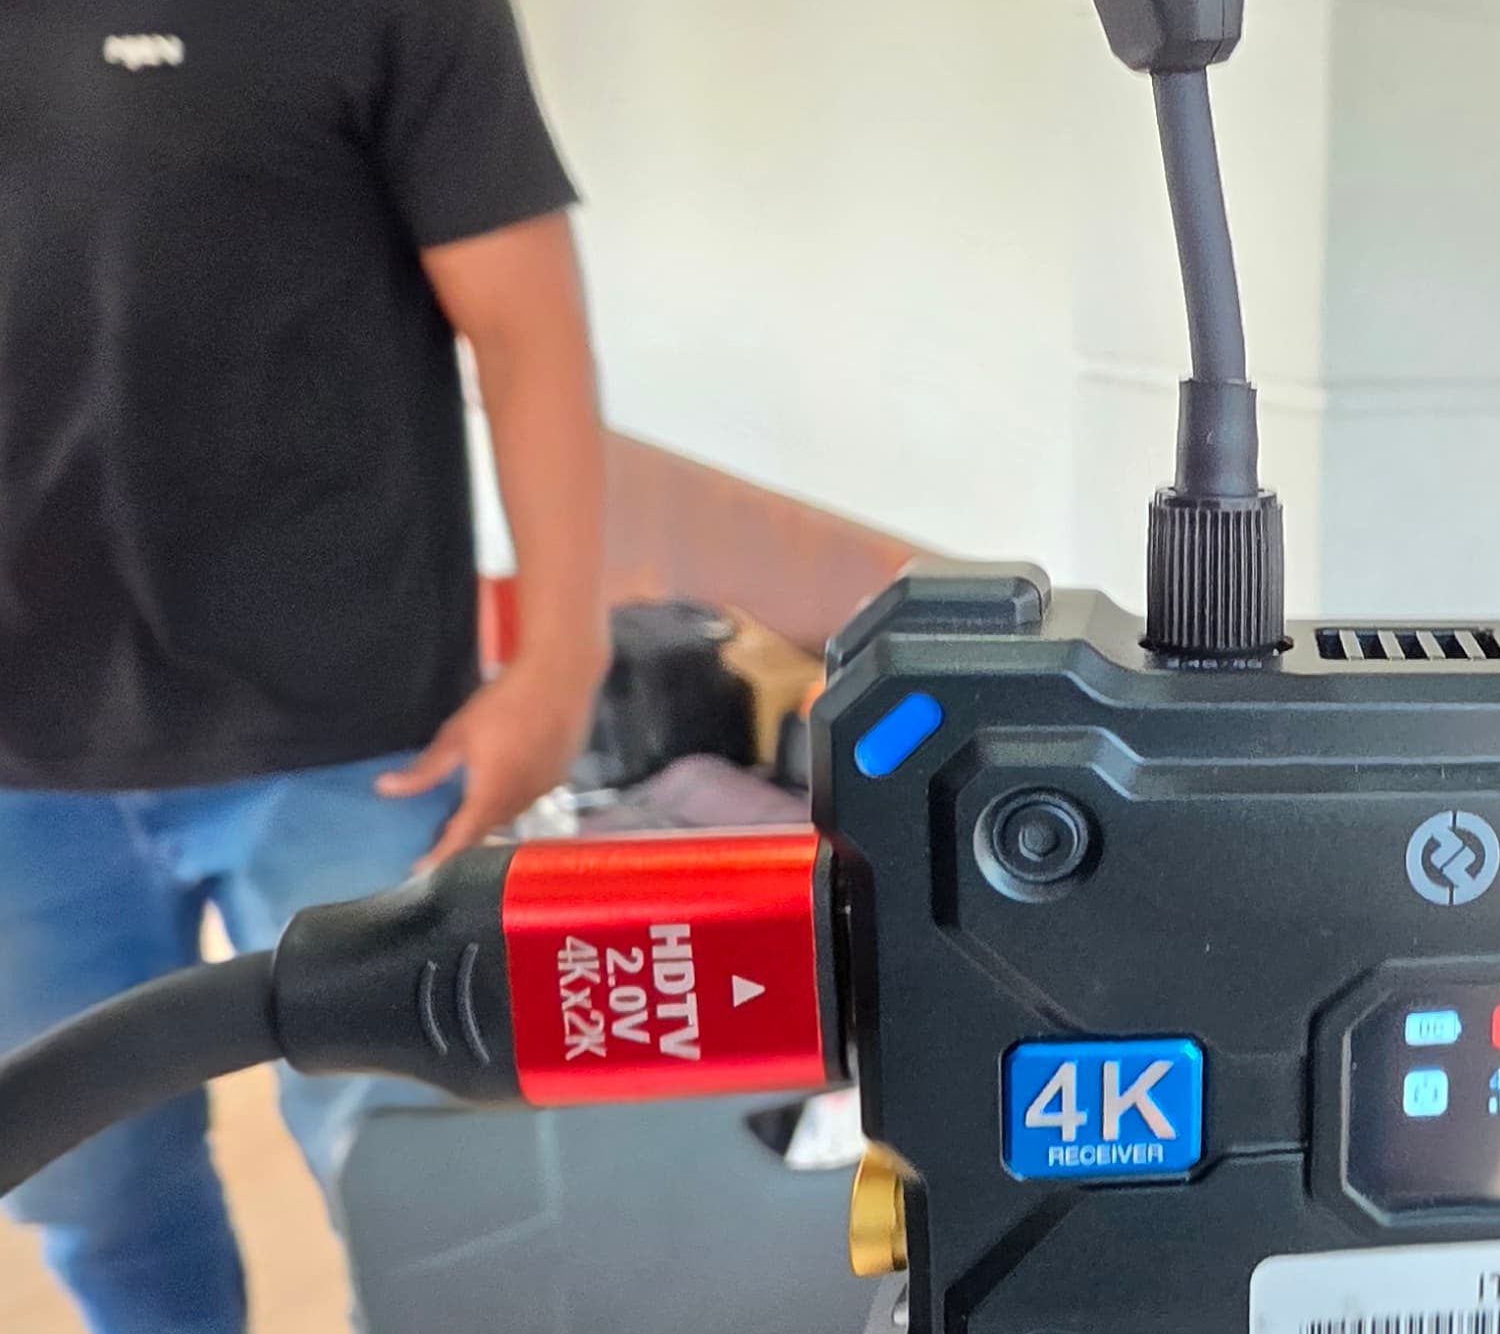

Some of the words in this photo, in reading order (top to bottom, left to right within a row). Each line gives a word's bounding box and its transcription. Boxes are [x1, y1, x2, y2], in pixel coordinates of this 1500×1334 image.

[605, 946, 651, 1044] 2.0V
[649, 923, 701, 1061] HDTV
[1025, 1060, 1176, 1142] 4K
[1048, 1143, 1163, 1167] RECEIVER
